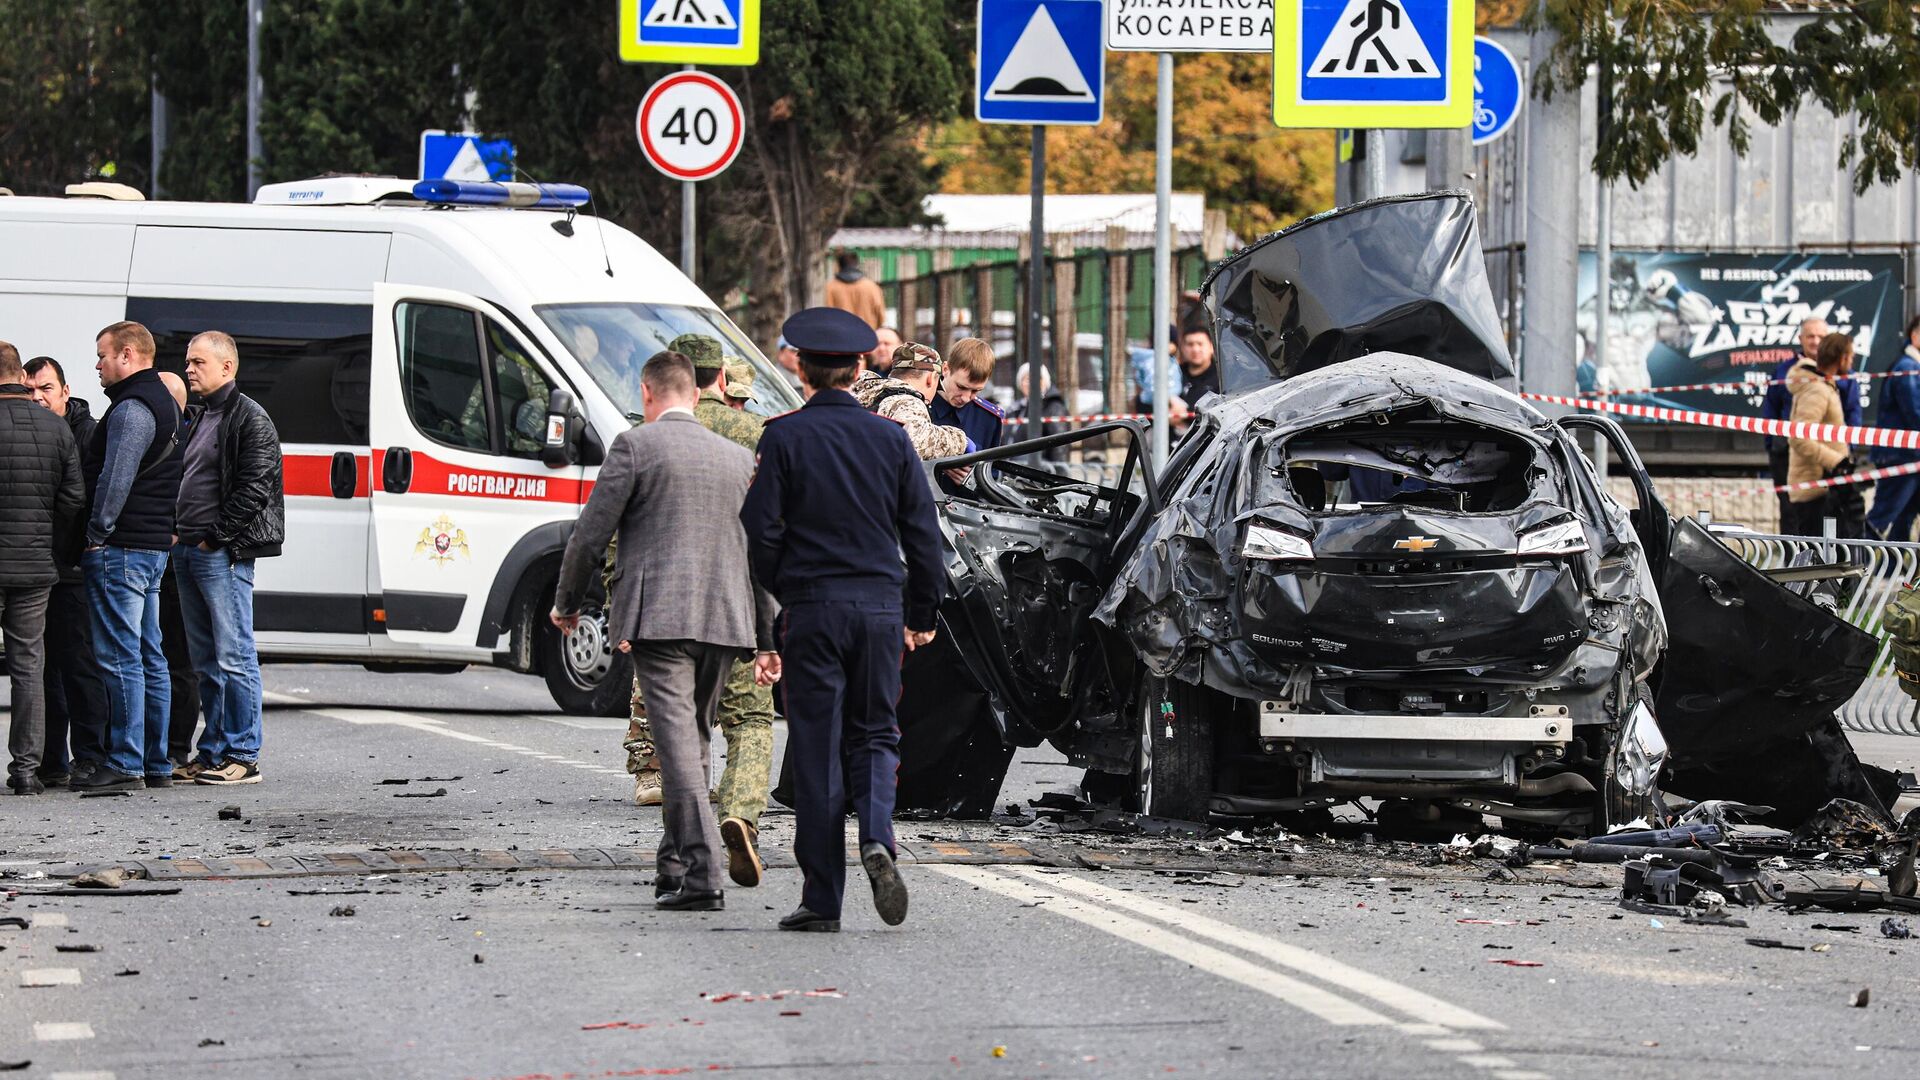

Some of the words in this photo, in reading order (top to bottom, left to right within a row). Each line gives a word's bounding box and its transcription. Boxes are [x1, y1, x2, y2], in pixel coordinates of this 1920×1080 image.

[1117, 15, 1273, 36] КОСАРЕВА
[661, 107, 717, 146] 40
[1700, 268, 1720, 281] НЕ
[447, 473, 547, 498] РОСГВАРДИЯ
[1252, 633, 1304, 648] EQUINOX
[1569, 629, 1581, 638] LT
